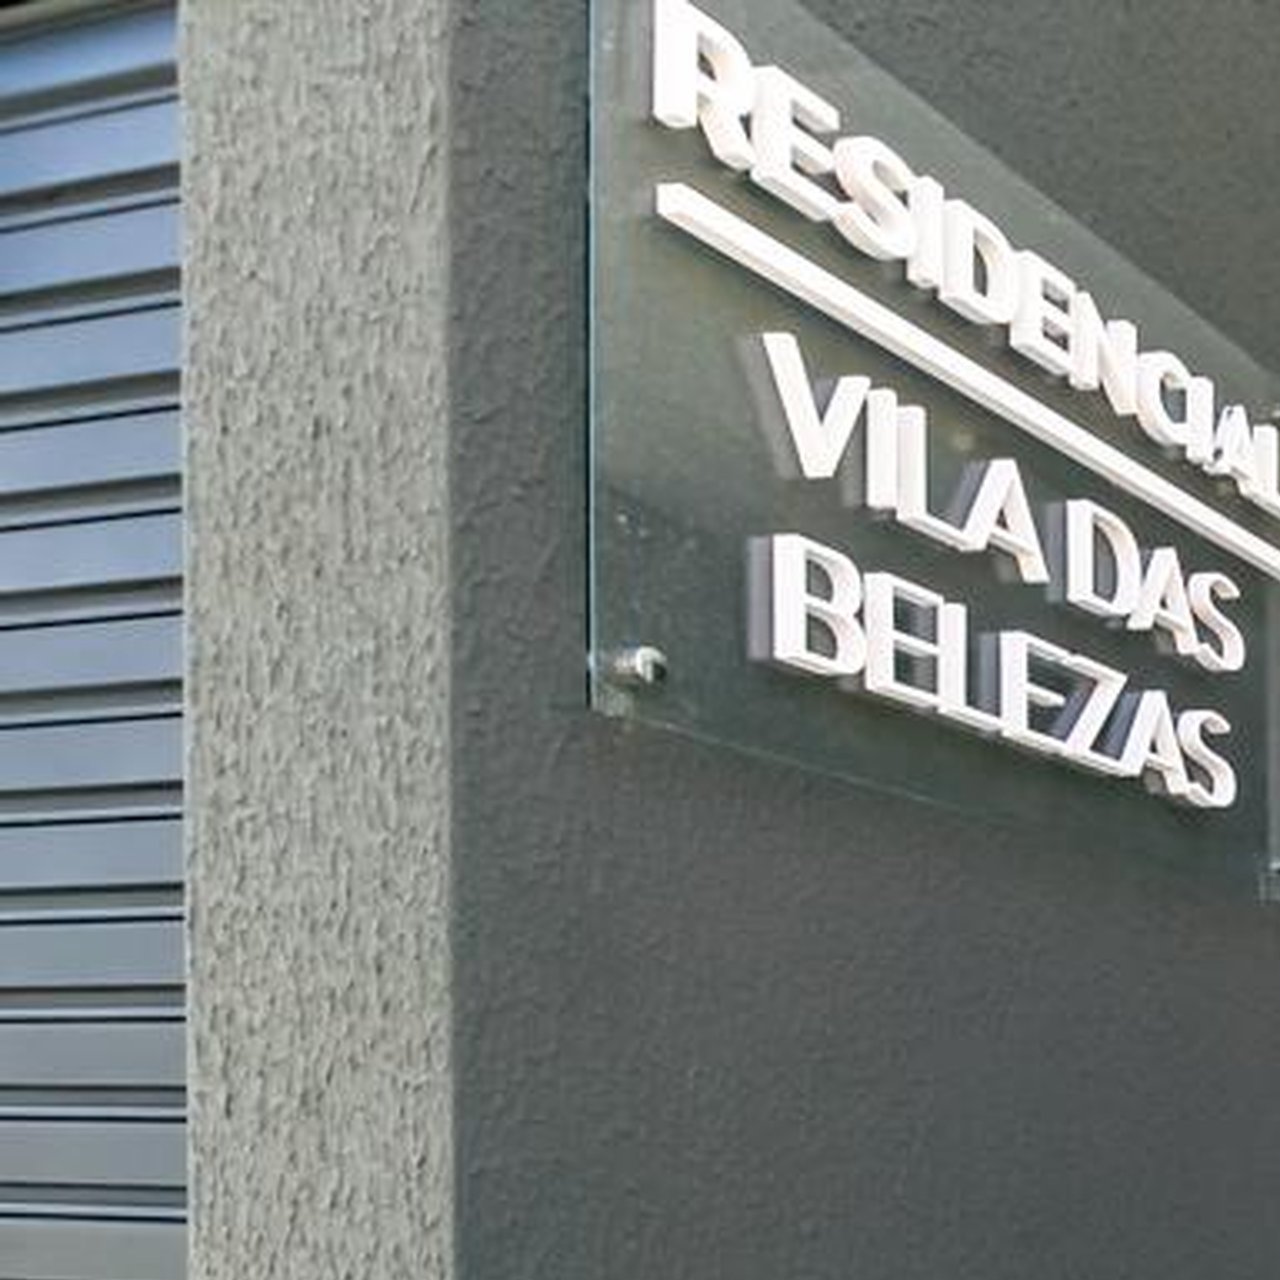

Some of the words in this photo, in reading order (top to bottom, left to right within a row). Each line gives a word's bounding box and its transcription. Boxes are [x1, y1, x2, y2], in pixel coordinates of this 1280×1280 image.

[763, 332, 1050, 585] VILA
[1065, 498, 1246, 672] DAS
[771, 533, 1237, 808] BELEZAS
